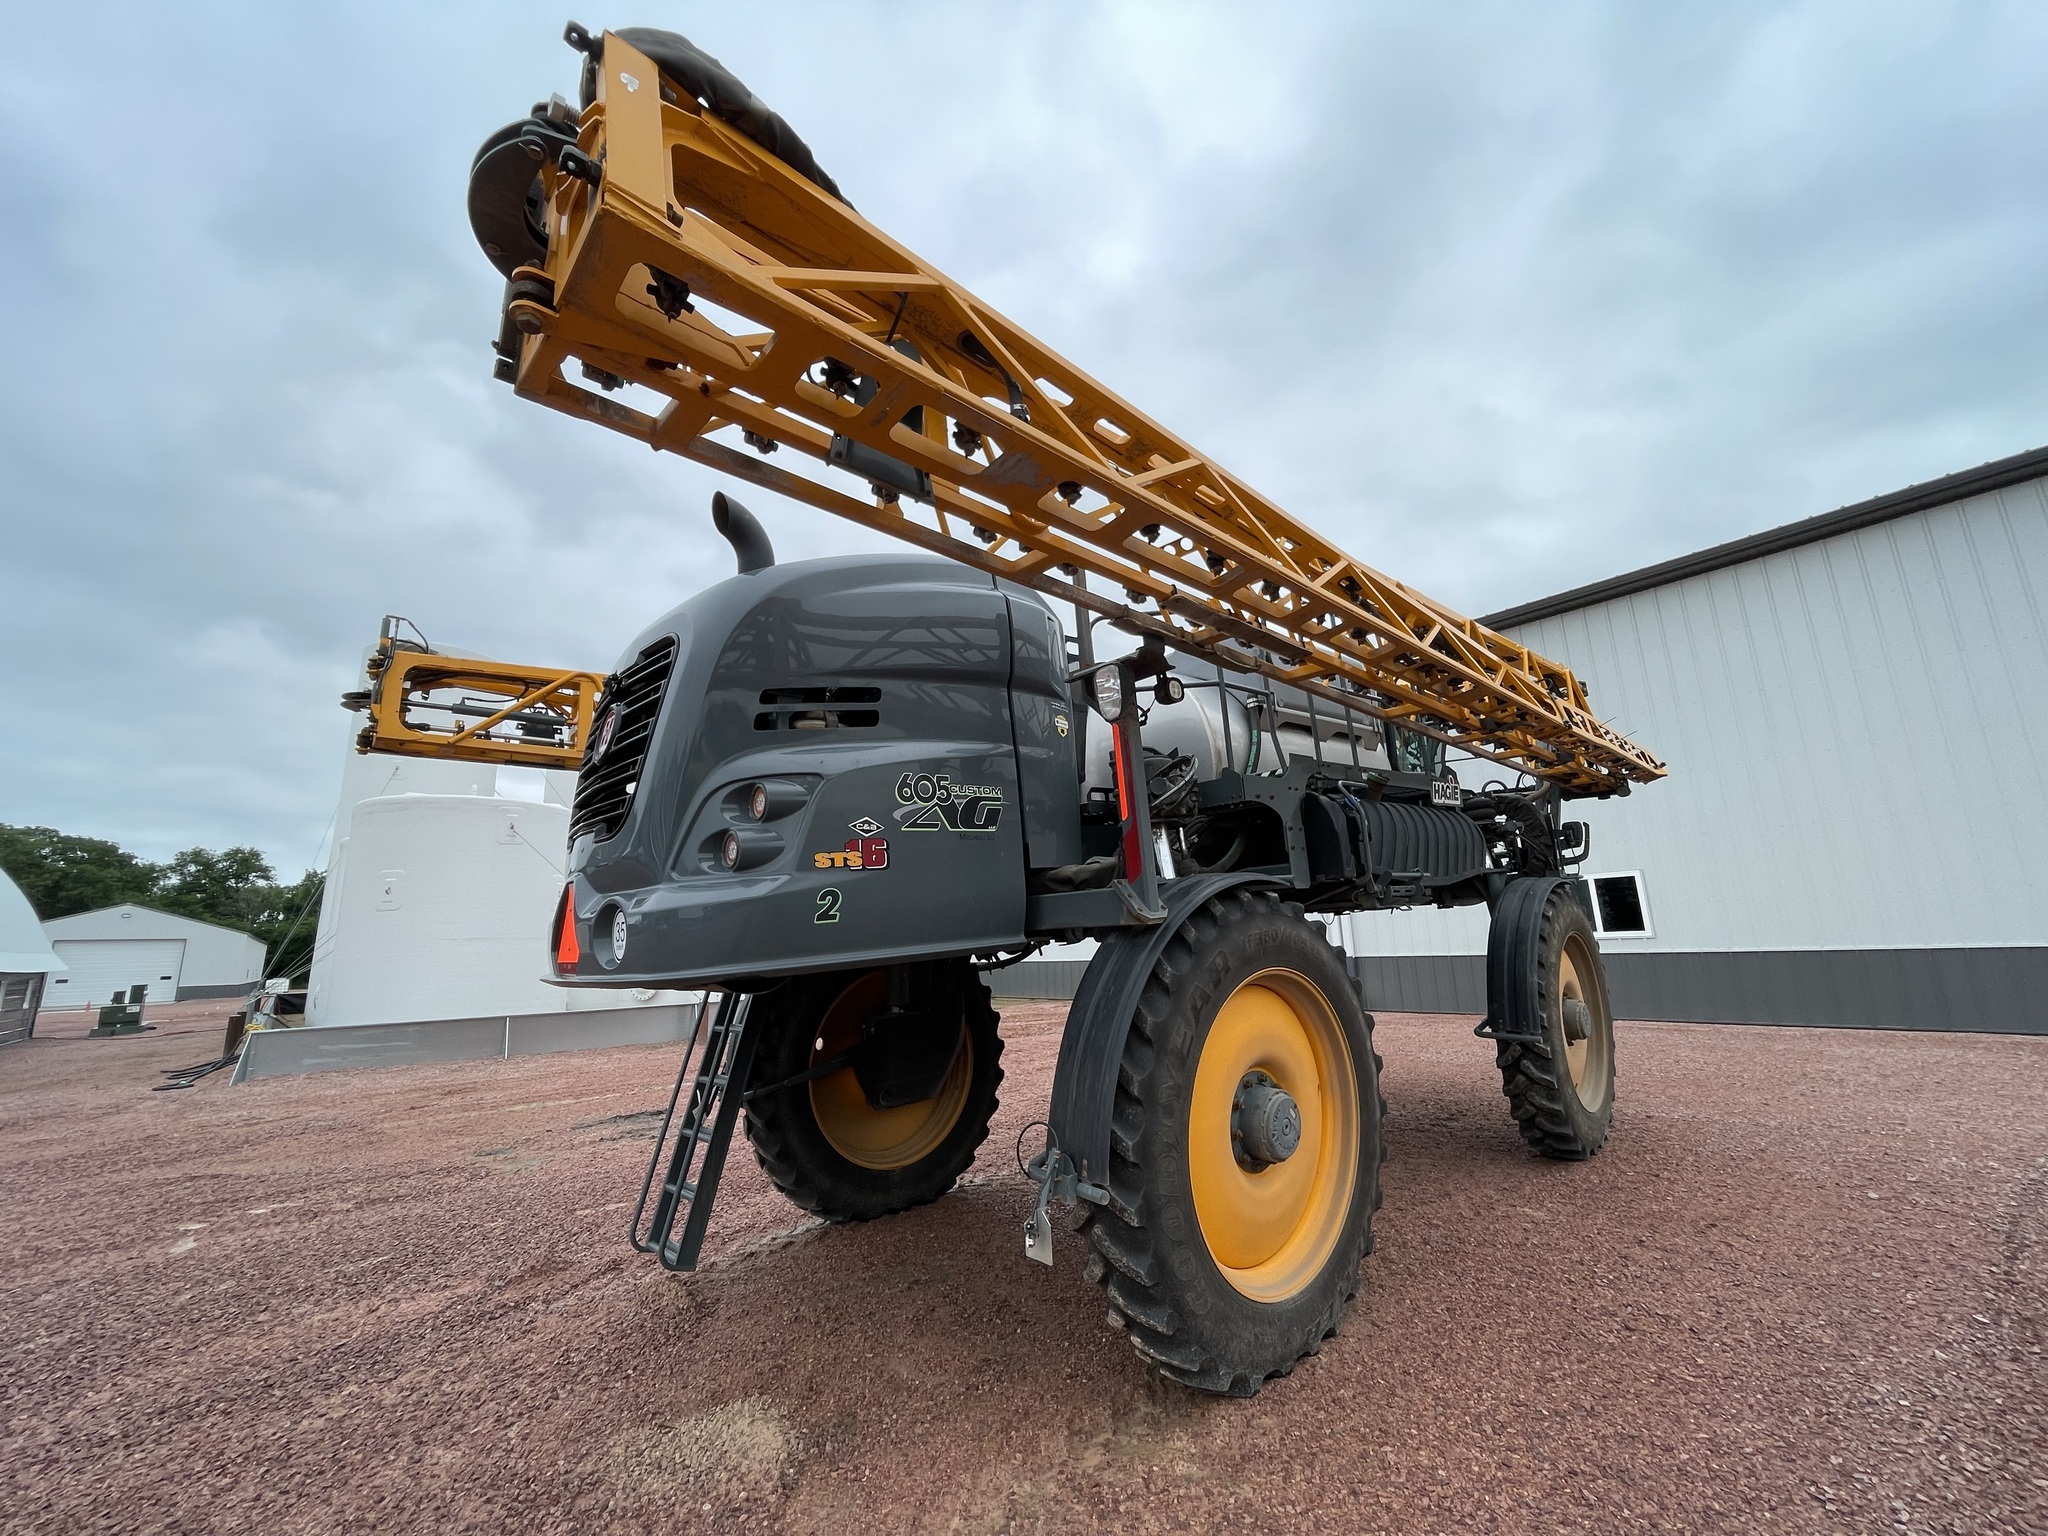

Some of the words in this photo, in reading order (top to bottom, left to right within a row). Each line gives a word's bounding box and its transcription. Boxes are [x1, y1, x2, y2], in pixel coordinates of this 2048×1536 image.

[896, 773, 953, 805] 605
[949, 785, 1002, 796] CUSTOM
[1433, 777, 1460, 803] HAGIE
[901, 795, 1002, 831] AG
[814, 851, 863, 869] STS
[814, 887, 842, 924] 2
[615, 921, 626, 943] 35
[1156, 949, 1232, 1315] GOODYEAR
